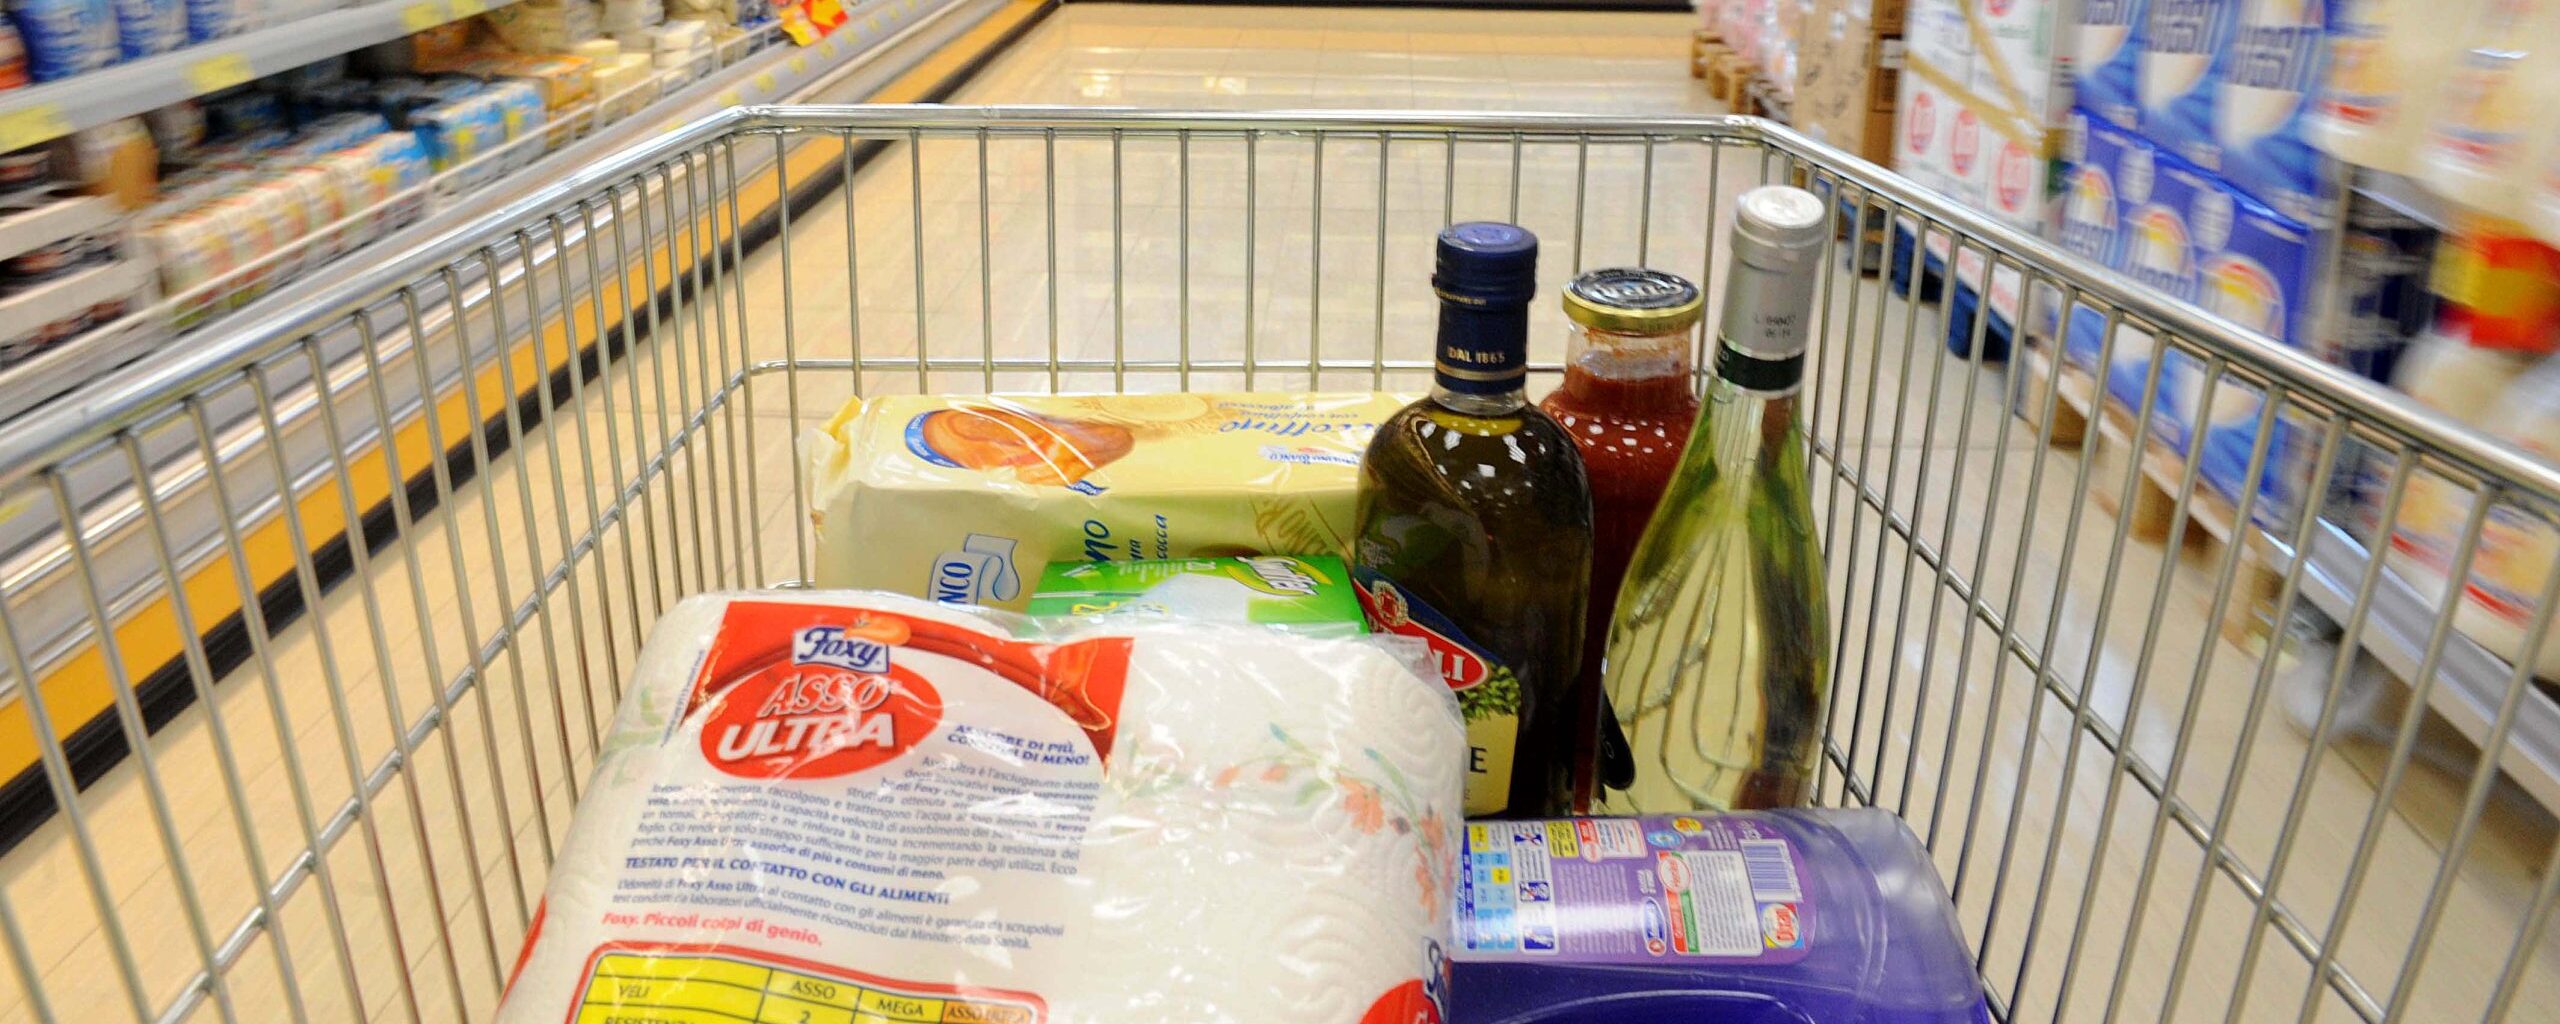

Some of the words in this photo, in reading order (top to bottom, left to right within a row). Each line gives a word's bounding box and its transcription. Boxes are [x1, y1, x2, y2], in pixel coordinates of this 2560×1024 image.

[1447, 345, 1473, 363] DAL
[1475, 350, 1506, 364] 1865
[797, 626, 881, 668] Foxy
[756, 672, 891, 718] ASSO
[716, 712, 895, 762] ULTRA
[1027, 739, 1044, 751] DI
[1041, 753, 1090, 767] MENO!
[847, 787, 895, 804] strutura
[901, 796, 946, 808] ottenuta
[914, 783, 940, 796] Foxy
[1063, 780, 1101, 791] dotato
[768, 786, 830, 807] raccolgono
[834, 800, 843, 809] e
[846, 801, 912, 821] trattengono
[915, 808, 951, 823] l'acqua
[1056, 822, 1087, 833] terzo
[783, 802, 829, 820] capacità
[842, 814, 884, 832] velocità
[886, 822, 897, 833] di
[899, 824, 970, 838] assorbimento
[734, 823, 756, 834] solo
[759, 826, 803, 843] strappo
[804, 834, 864, 857] sufficiente
[865, 849, 885, 861] per
[887, 850, 897, 861] la
[900, 851, 946, 866] maggior
[946, 855, 976, 868] parte
[977, 857, 1005, 871] degli
[1051, 863, 1077, 875] Ecco
[783, 816, 797, 827] ne
[803, 820, 846, 839] rinforza
[850, 830, 860, 842] la
[865, 833, 897, 847] trama
[902, 838, 983, 852] incrementando
[988, 842, 997, 853] la
[1002, 844, 1056, 859] resistenza
[667, 836, 690, 847] Foxy
[693, 837, 718, 847] Asso
[750, 840, 796, 855] assorbe
[799, 845, 810, 857] di
[812, 848, 833, 864] più
[835, 855, 843, 865] e
[844, 858, 896, 875] consumi
[897, 866, 908, 877] di
[911, 868, 946, 880] meno.
[624, 857, 679, 869] TESTATO
[712, 857, 726, 870] IL
[812, 869, 846, 890] CON
[849, 880, 876, 897] GLI
[878, 887, 950, 905] ALIMENTI
[689, 894, 743, 908] laboratori
[744, 896, 820, 921] ufficialmente
[820, 911, 890, 937] riconosciuti
[890, 926, 908, 939] dal
[706, 880, 733, 892] Asso
[736, 881, 766, 895] Ultr
[768, 885, 779, 896] al
[781, 888, 831, 908] contatto
[834, 902, 857, 915] con
[858, 906, 875, 920] gli
[876, 909, 922, 924] alimenti
[926, 914, 933, 926] è
[1005, 921, 1065, 937] scrupolosi
[602, 911, 640, 926] Foxy.
[643, 911, 698, 930] Piccoli
[701, 916, 743, 932] colpi
[745, 916, 763, 933] di
[766, 922, 823, 947] genio.
[618, 984, 650, 998] VELI
[793, 978, 837, 999] ASSO
[800, 1010, 811, 1024] 2
[876, 998, 924, 1017] MEGA
